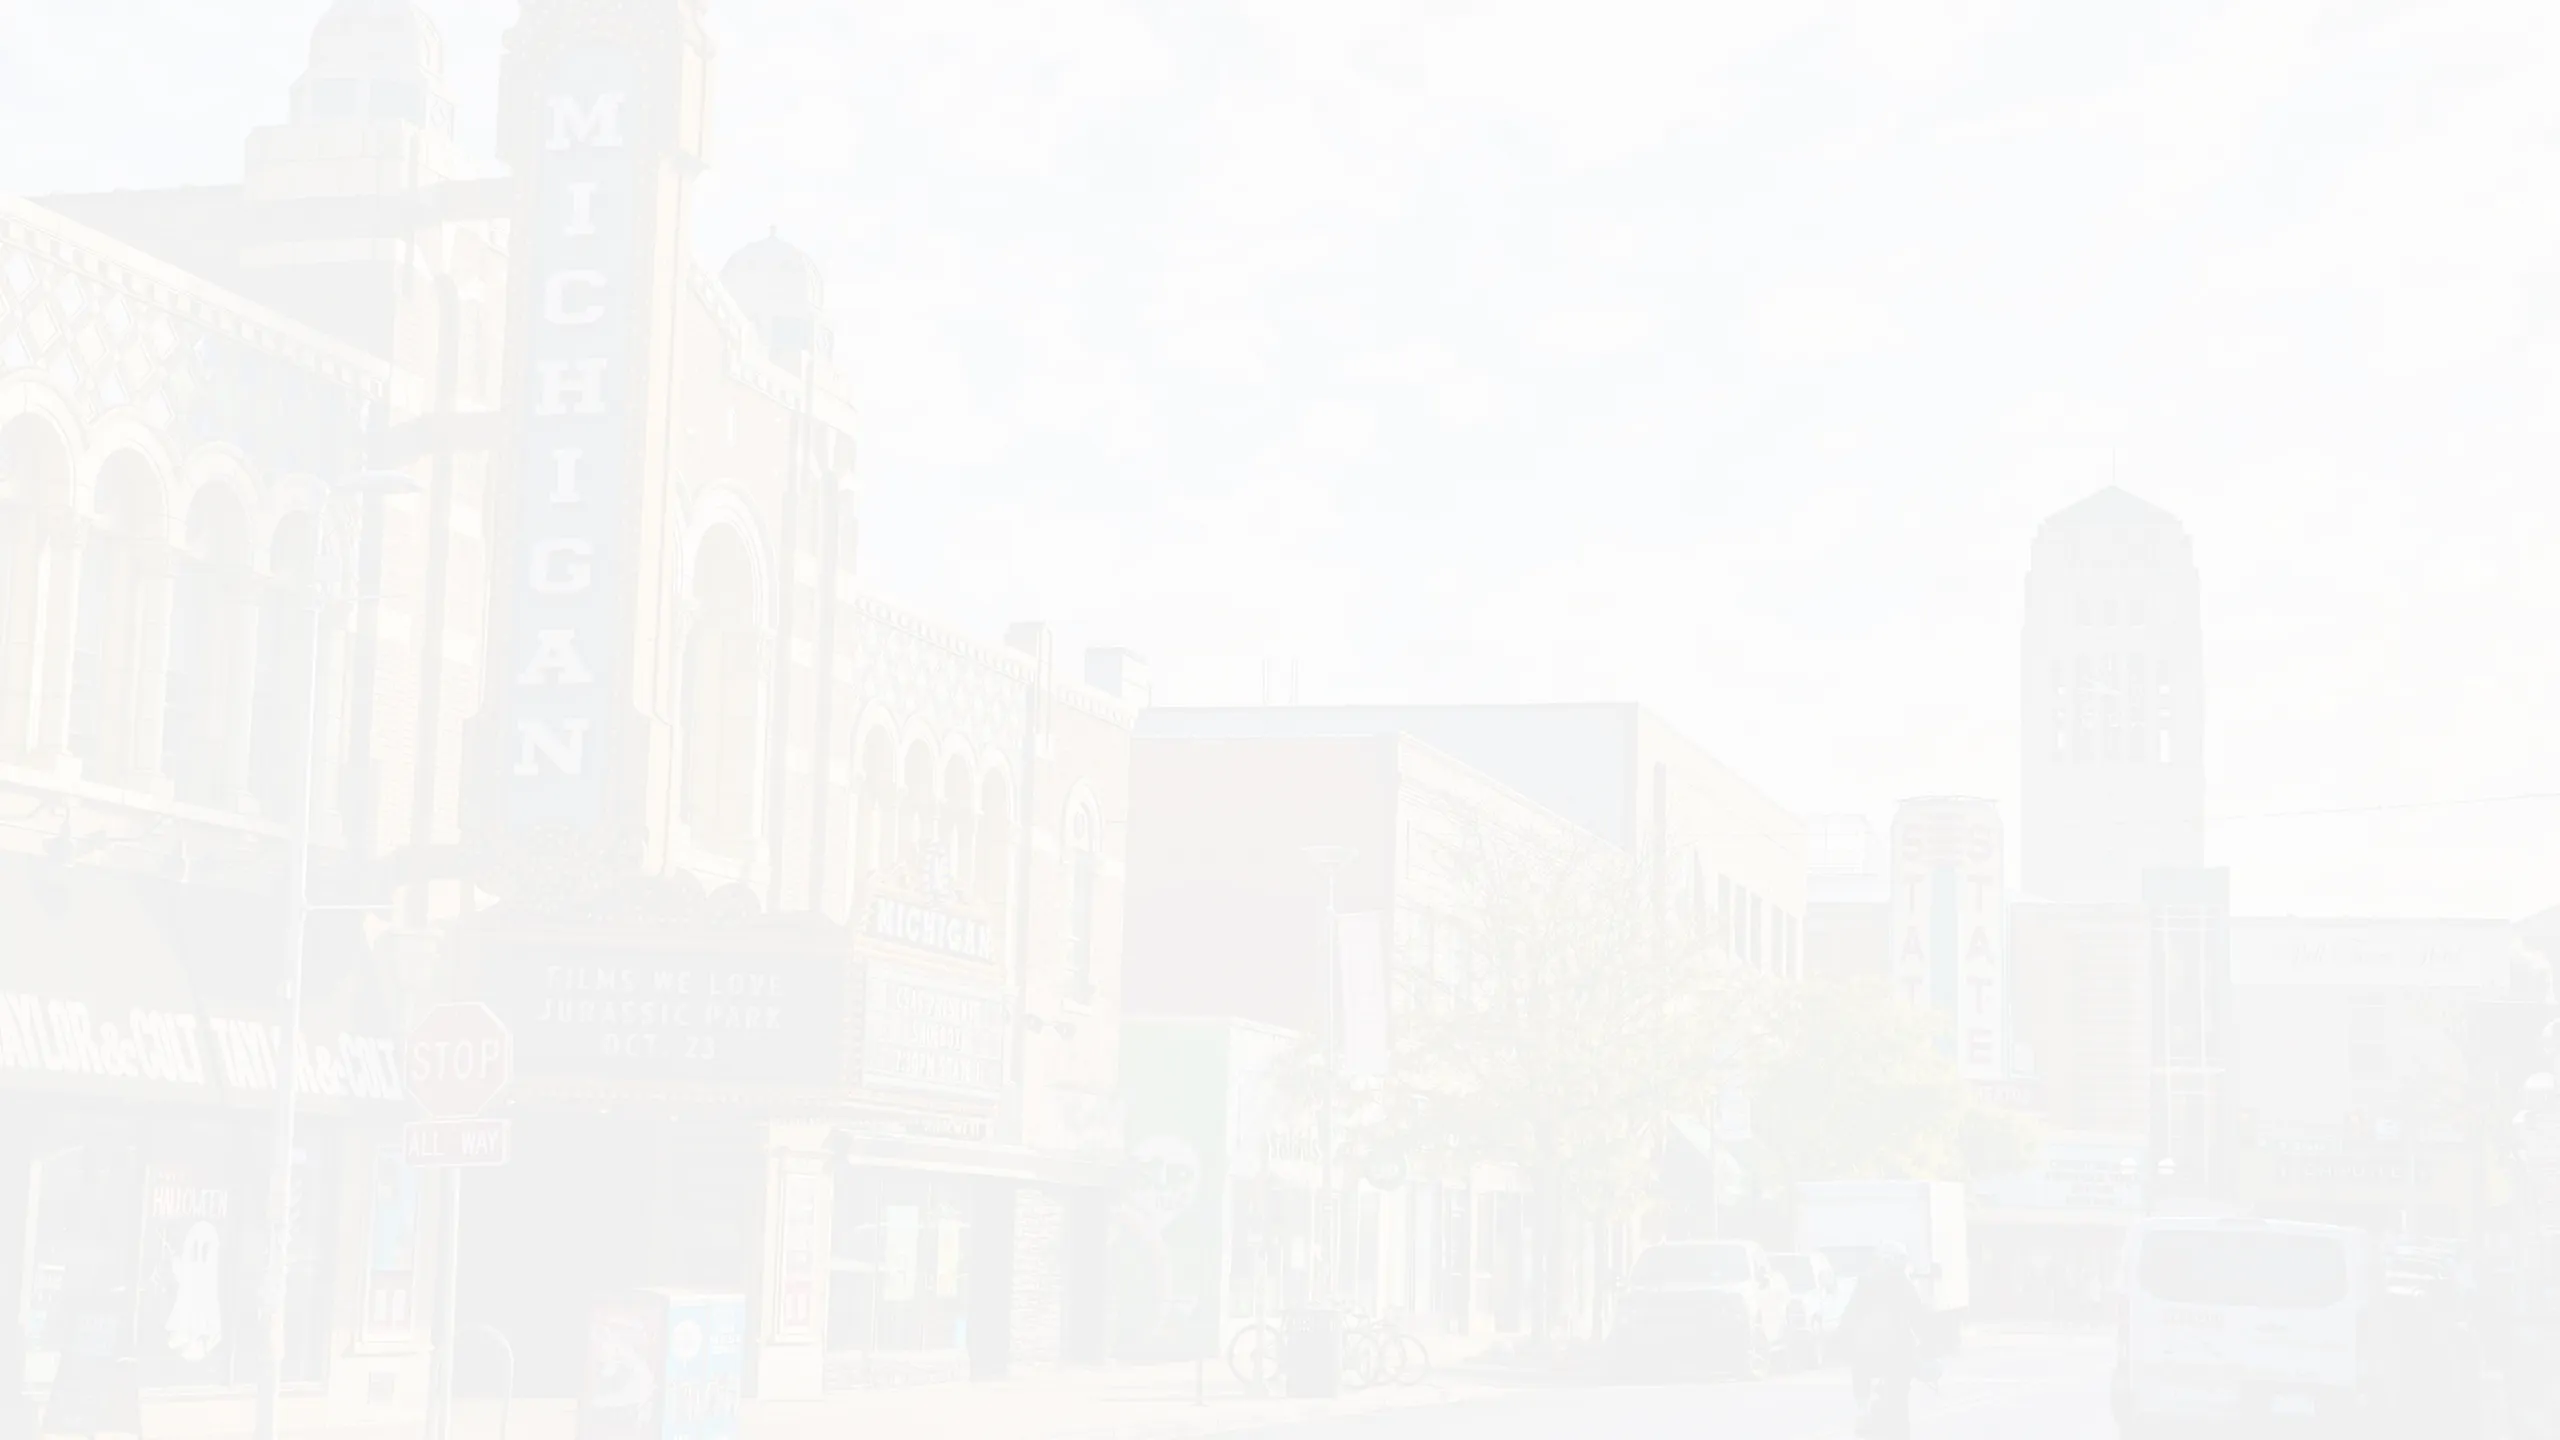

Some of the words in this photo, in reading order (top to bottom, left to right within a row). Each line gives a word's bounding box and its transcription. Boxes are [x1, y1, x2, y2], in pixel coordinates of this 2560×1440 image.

[513, 90, 627, 776] MICHIGAN
[877, 898, 993, 961] MICHIGAN
[1900, 822, 1926, 1007] STAT
[1965, 822, 1995, 1066] STATE
[546, 964, 636, 992] FILMS
[652, 969, 691, 995] WE
[709, 970, 785, 997] LOVE
[537, 998, 691, 1026] JURASSIC
[705, 1004, 781, 1030] PARK
[413, 1037, 499, 1081] STOP
[602, 1033, 669, 1058] OCT.
[684, 1034, 717, 1060] 23
[409, 1130, 445, 1157] ALL
[461, 1129, 499, 1157] WAY
